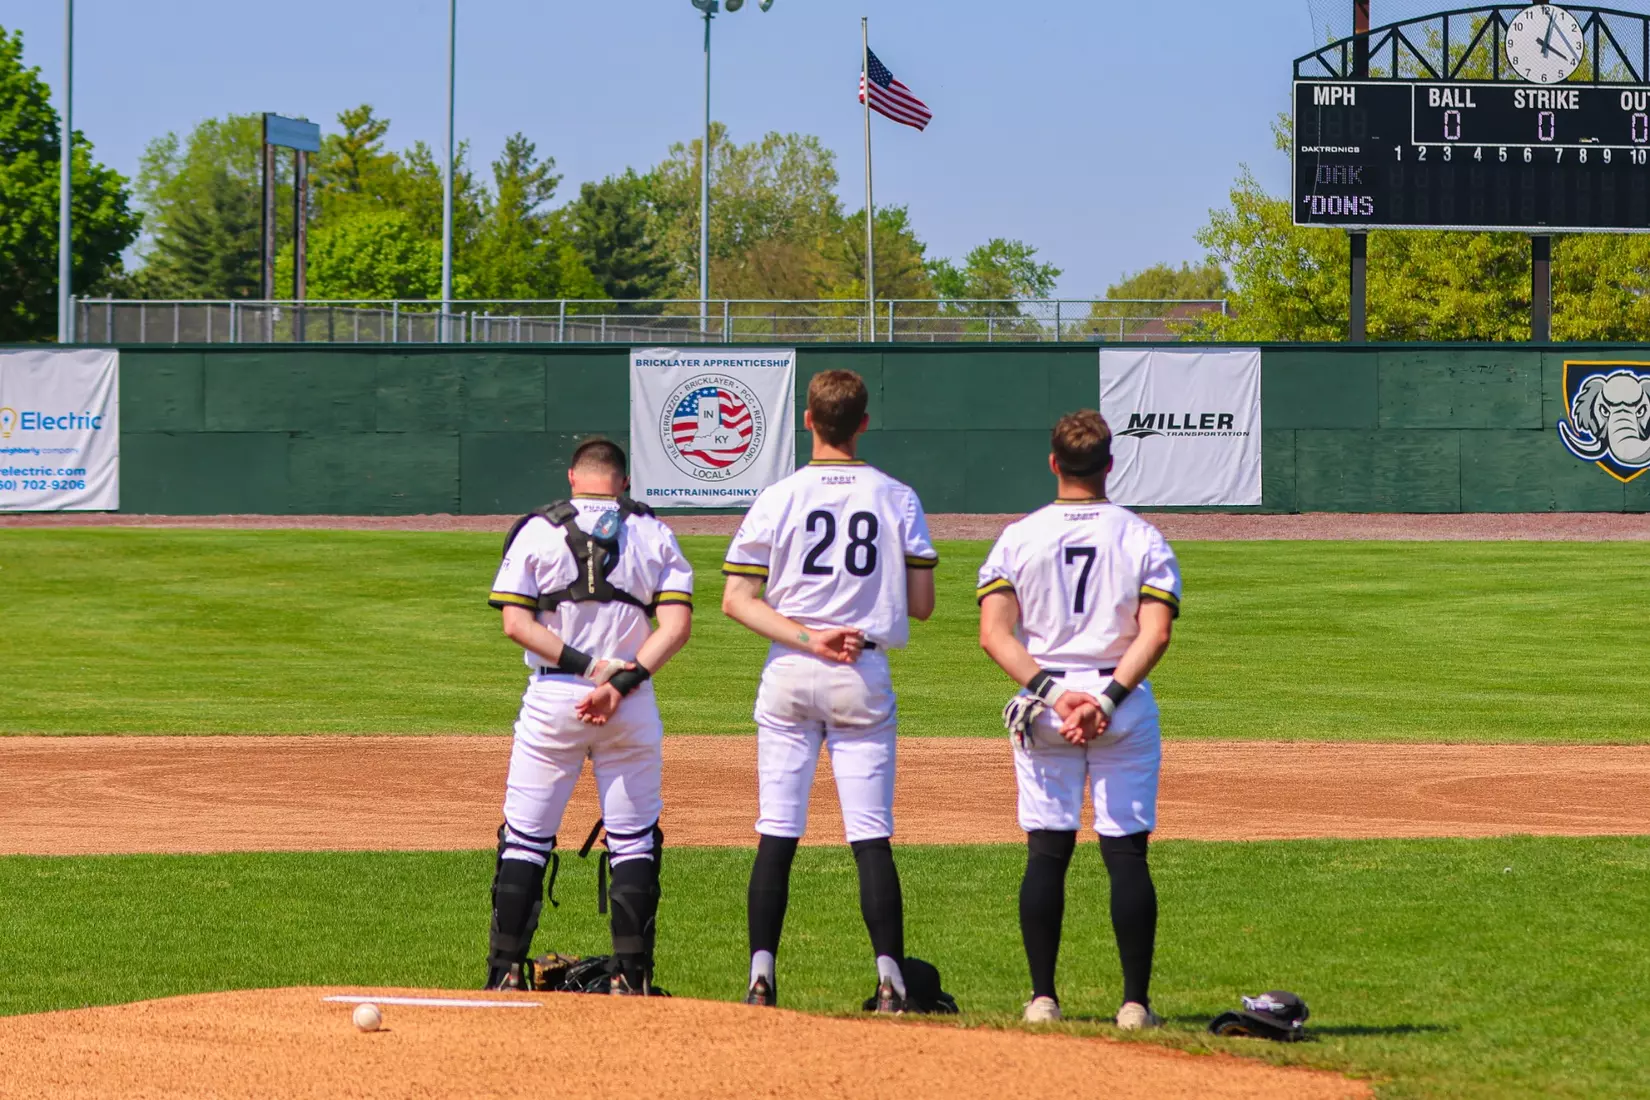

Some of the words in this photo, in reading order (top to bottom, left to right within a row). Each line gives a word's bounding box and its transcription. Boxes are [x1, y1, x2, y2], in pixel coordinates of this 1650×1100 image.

[1513, 22, 1523, 31] 10
[1571, 24, 1578, 32] 2
[1508, 39, 1514, 48] 9
[1576, 42, 1582, 50] 3
[1512, 57, 1519, 65] 8
[1525, 68, 1531, 77] 7
[1541, 74, 1547, 82] 6
[1558, 70, 1564, 78] 5
[1313, 86, 1355, 106] MPH
[1429, 88, 1476, 108] BALL
[1514, 89, 1579, 109] STRIKE
[1444, 110, 1460, 140] 0
[1538, 111, 1554, 141] 0
[1632, 113, 1648, 142] 0
[1394, 145, 1401, 161] 1
[1418, 146, 1426, 161] 2
[1443, 146, 1451, 161] 3
[1474, 146, 1482, 162] 4
[1499, 147, 1507, 162] 5
[1524, 148, 1532, 162] 6
[1555, 148, 1563, 163] 7
[1579, 148, 1587, 163] 8
[1603, 148, 1611, 164] 9
[1630, 149, 1646, 165] 10
[684, 377, 734, 391] BRICKLAYER
[740, 389, 753, 404] PCC
[21, 412, 102, 430] Electric
[663, 394, 680, 436] TERRAZZO
[703, 410, 714, 418] IN
[1128, 413, 1234, 430] MILLER
[714, 435, 729, 444] KY
[743, 410, 763, 463] REFRACTORY
[666, 444, 680, 460] TILE
[0, 466, 86, 476] electric.com
[692, 468, 725, 478] LOCAL
[22, 480, 85, 490] 702-9206
[802, 510, 878, 577] 28
[1065, 546, 1097, 613] 7
